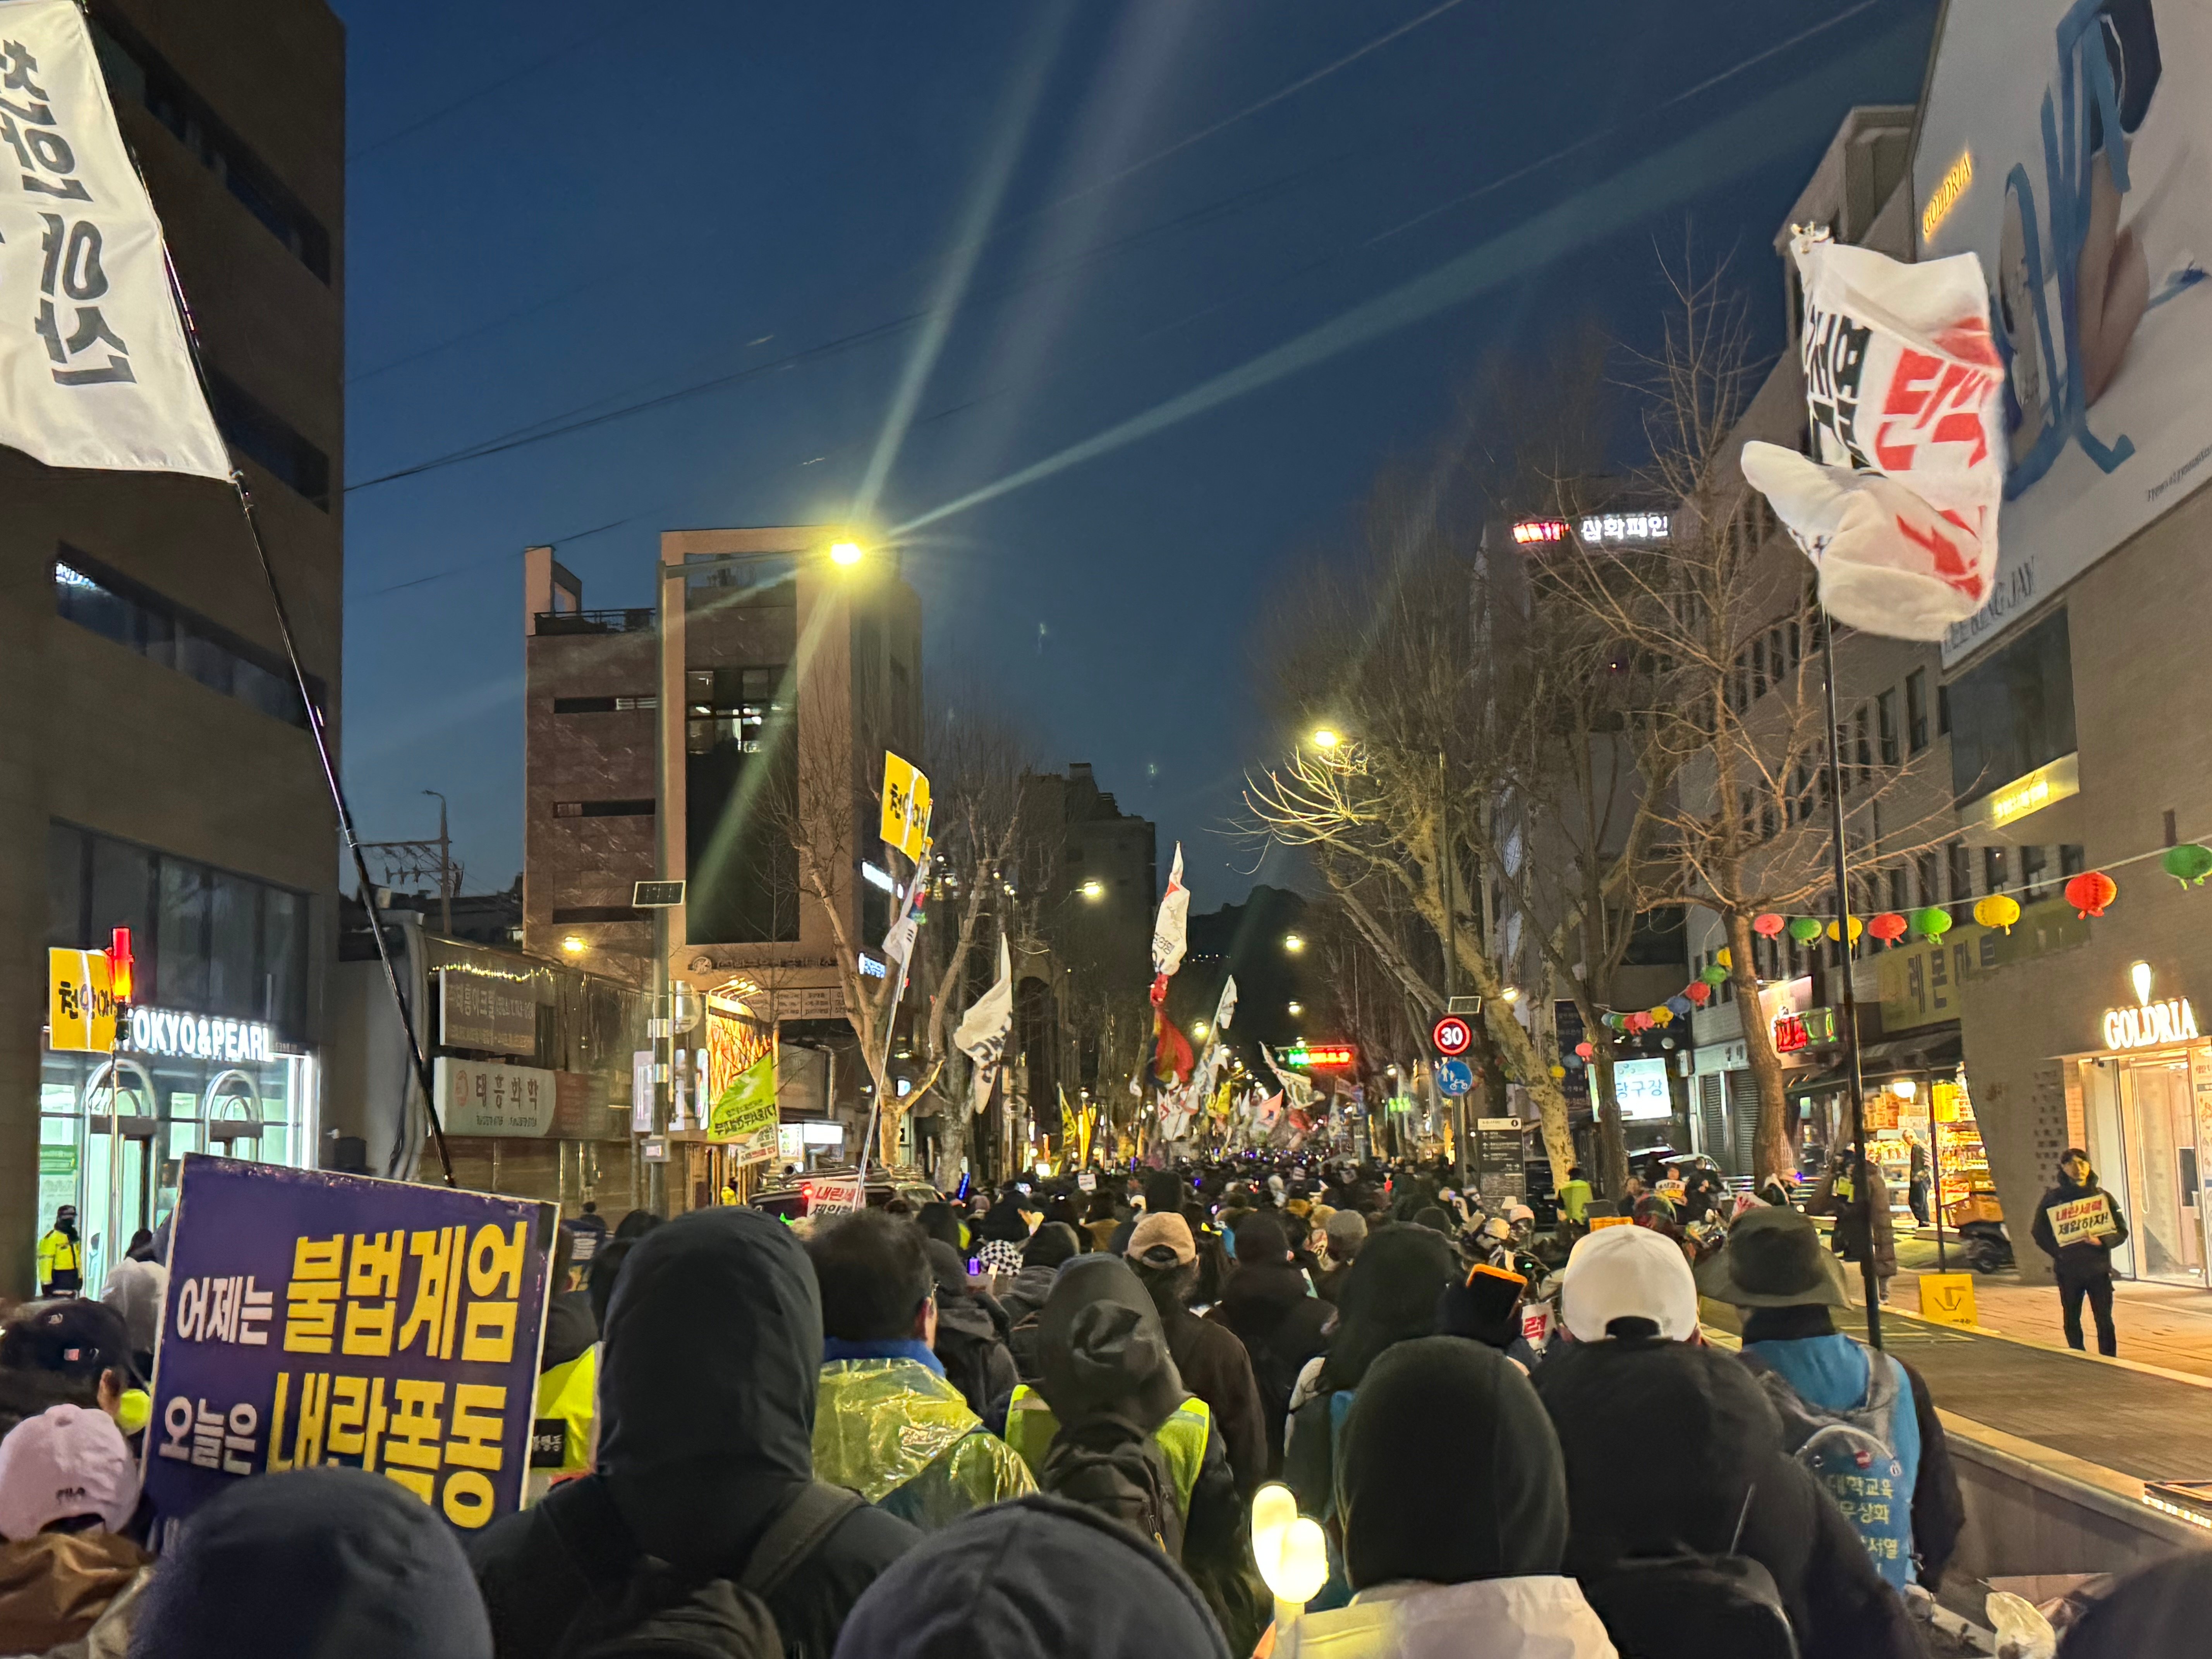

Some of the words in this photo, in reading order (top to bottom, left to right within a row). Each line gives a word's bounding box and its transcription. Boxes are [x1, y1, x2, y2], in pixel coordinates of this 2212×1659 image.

[1923, 154, 1971, 234] GOLDRIA
[124, 1008, 273, 1062] OKYO&PEARL
[1441, 1027, 1463, 1046] 30
[2104, 998, 2199, 1050] GOLDRIA
[1616, 1079, 1662, 1099] 당구장
[2056, 1199, 2102, 1221] 내란세력
[2058, 1212, 2108, 1235] 제압하자!
[177, 1275, 273, 1345] 어제는
[283, 1221, 527, 1363] 불법계엄
[159, 1396, 258, 1475] 오늘은
[266, 1372, 507, 1528] 내란폭동
[1827, 1474, 1895, 1499] 대학교육
[1860, 1534, 1899, 1560] 서열
